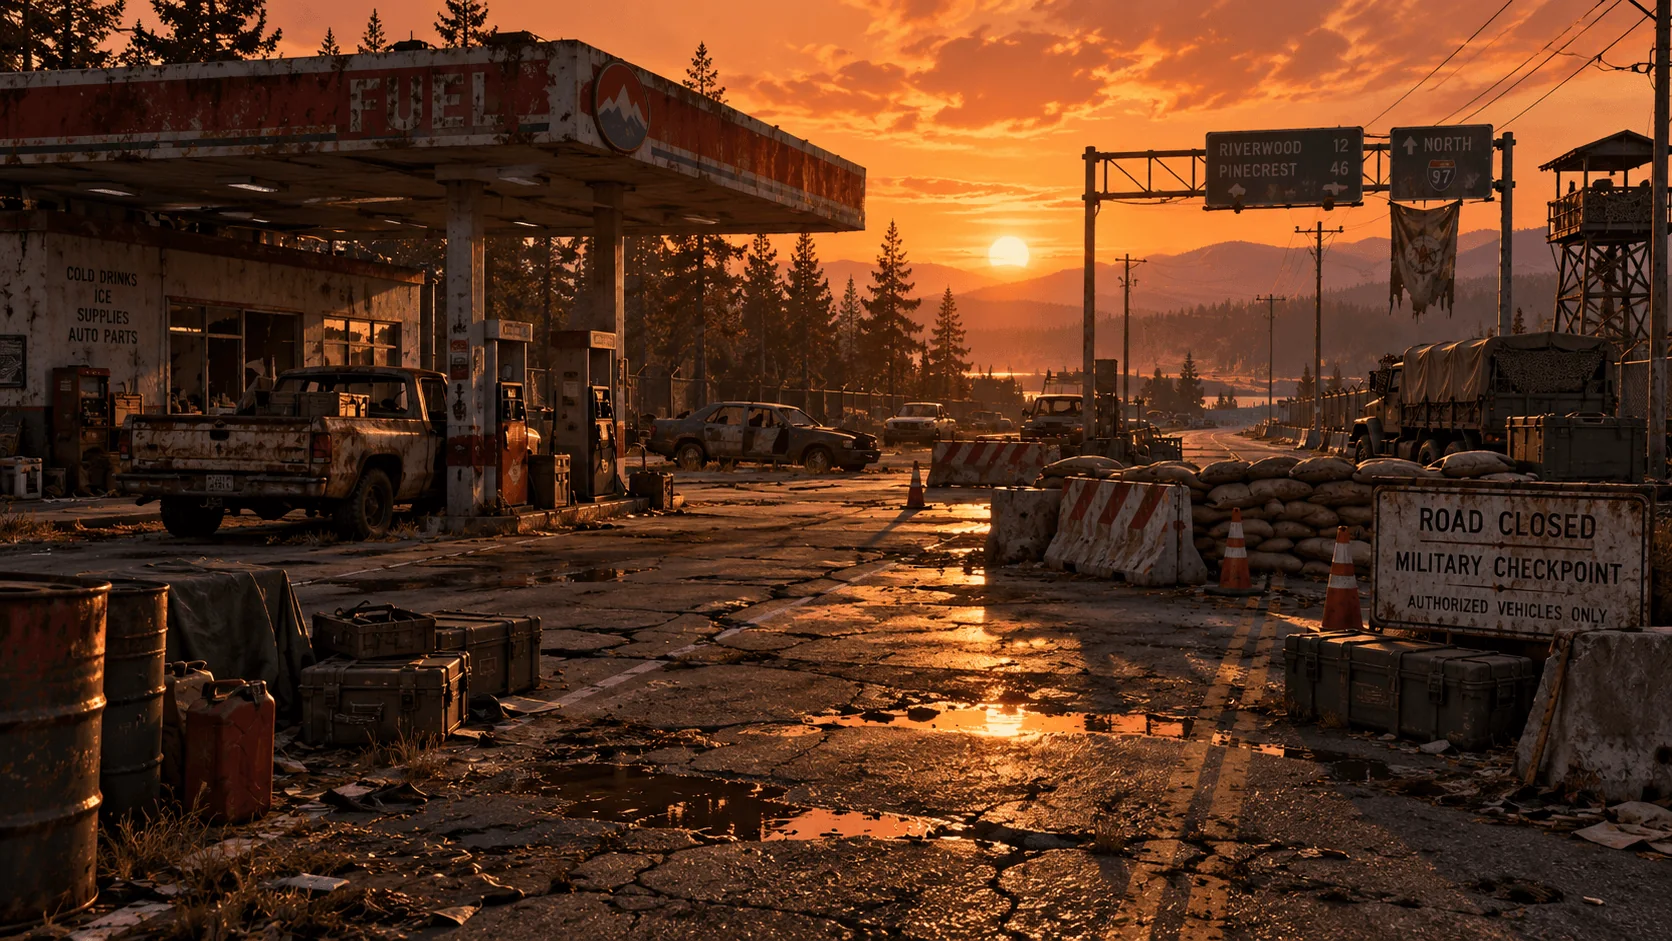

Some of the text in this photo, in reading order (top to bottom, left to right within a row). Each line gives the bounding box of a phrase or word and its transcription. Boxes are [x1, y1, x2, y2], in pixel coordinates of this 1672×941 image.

[350, 72, 504, 132] FUEL
[1219, 138, 1349, 157] RIVERWOOD 12
[1424, 136, 1472, 153] NORTH
[1219, 161, 1349, 178] PINECREST 46
[1431, 169, 1451, 184] 97
[66, 266, 138, 287] COLD DRINKS
[94, 288, 112, 304] ICE
[77, 307, 129, 325] SUPPLIES
[68, 327, 138, 344] AUTO PARTS
[1420, 507, 1597, 540] ROAD CLOSED
[1395, 551, 1623, 585] MILITARY CHECKPOINT
[1407, 594, 1608, 625] AUTHORIZED VEHICLES ONLY
